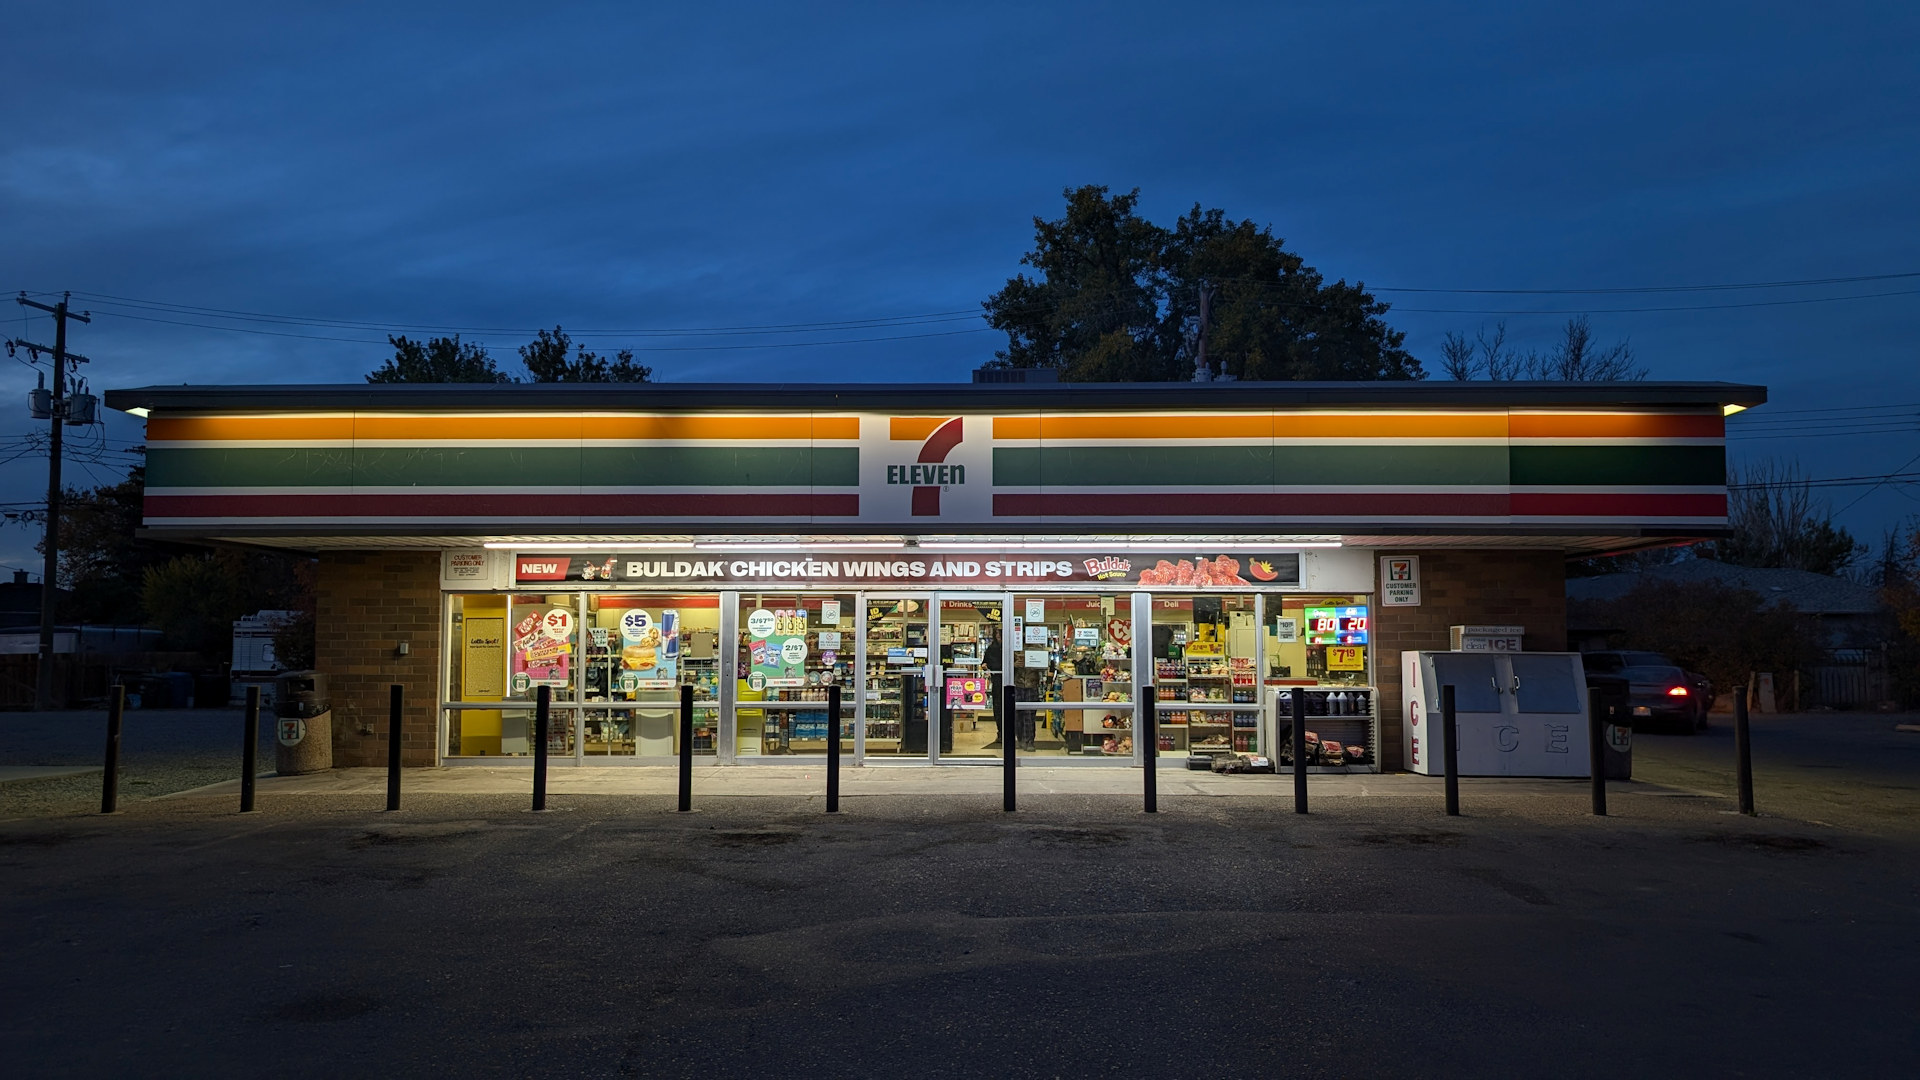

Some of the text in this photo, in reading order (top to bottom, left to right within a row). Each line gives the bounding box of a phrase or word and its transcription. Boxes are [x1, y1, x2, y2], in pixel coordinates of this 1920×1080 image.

[890, 416, 963, 516] 7
[521, 563, 558, 574] NEW
[626, 561, 1073, 577] BULDAK CHICKEN WINGS AND STRIPS
[1083, 556, 1131, 576] Buldak
[1394, 563, 1407, 579] 7
[1097, 572, 1108, 580] Hot
[868, 612, 884, 620] ZONE
[986, 613, 1001, 621] ZONE
[991, 608, 1000, 616] ID
[547, 613, 567, 627] $1
[625, 615, 647, 627] $5
[1318, 618, 1336, 631] 80
[1348, 617, 1366, 631] 20
[1110, 620, 1131, 641] ty
[1466, 639, 1517, 651] clear ICE
[1410, 661, 1420, 765] ICE
